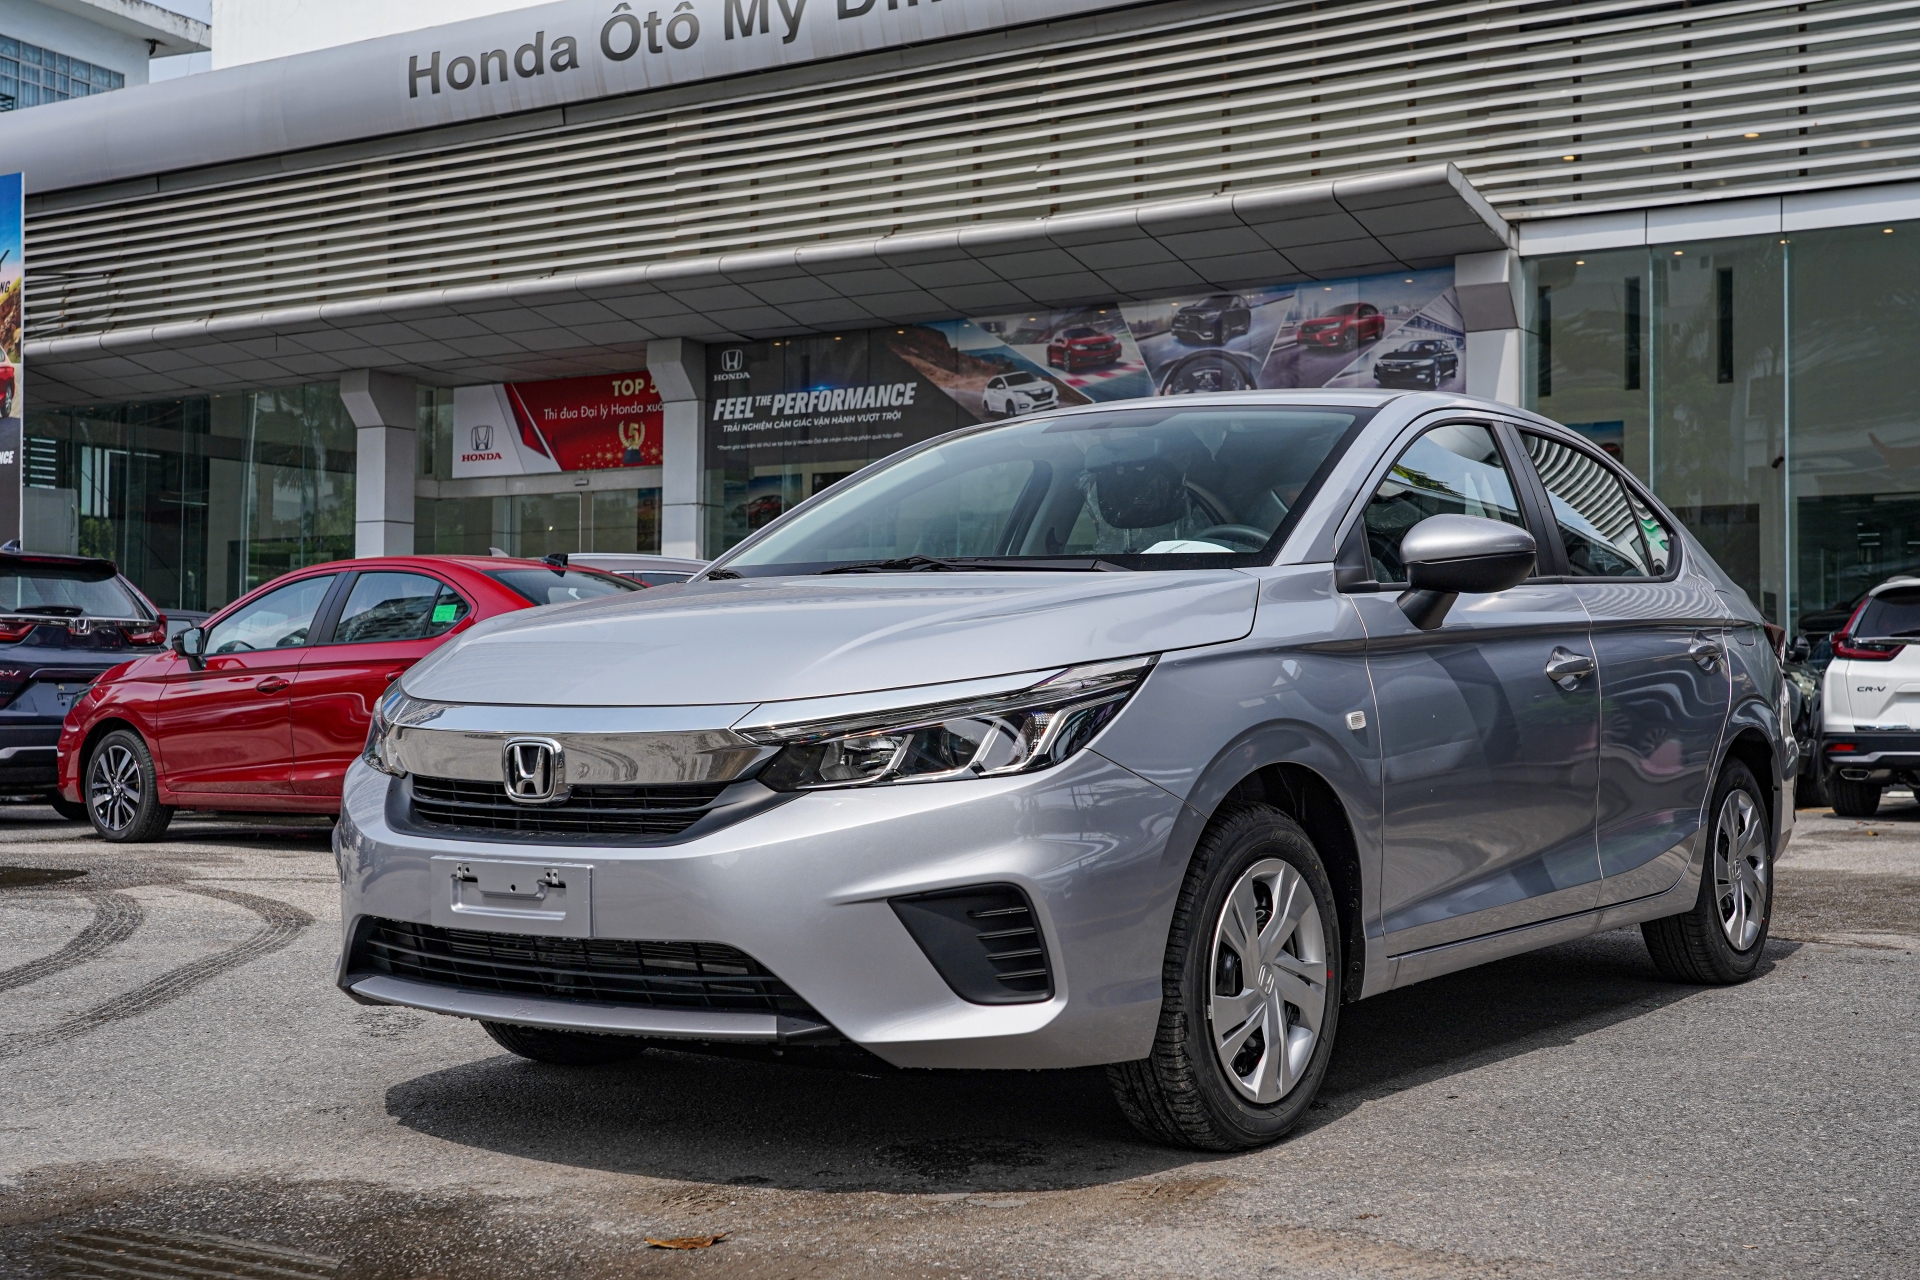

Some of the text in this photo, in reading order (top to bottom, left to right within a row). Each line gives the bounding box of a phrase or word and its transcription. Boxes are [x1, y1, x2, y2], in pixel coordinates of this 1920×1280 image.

[408, 31, 580, 99] Honda
[600, 1, 700, 62] Ôtô
[713, 371, 750, 382] HONDA
[612, 378, 645, 397] TOP
[543, 407, 558, 421] Thi
[559, 406, 578, 420] đua
[580, 405, 598, 419] Đại
[600, 403, 609, 420] lý
[611, 401, 644, 416] Honda
[713, 382, 917, 421] FEEL THE PERFORMANCE
[461, 452, 502, 463] HONDA
